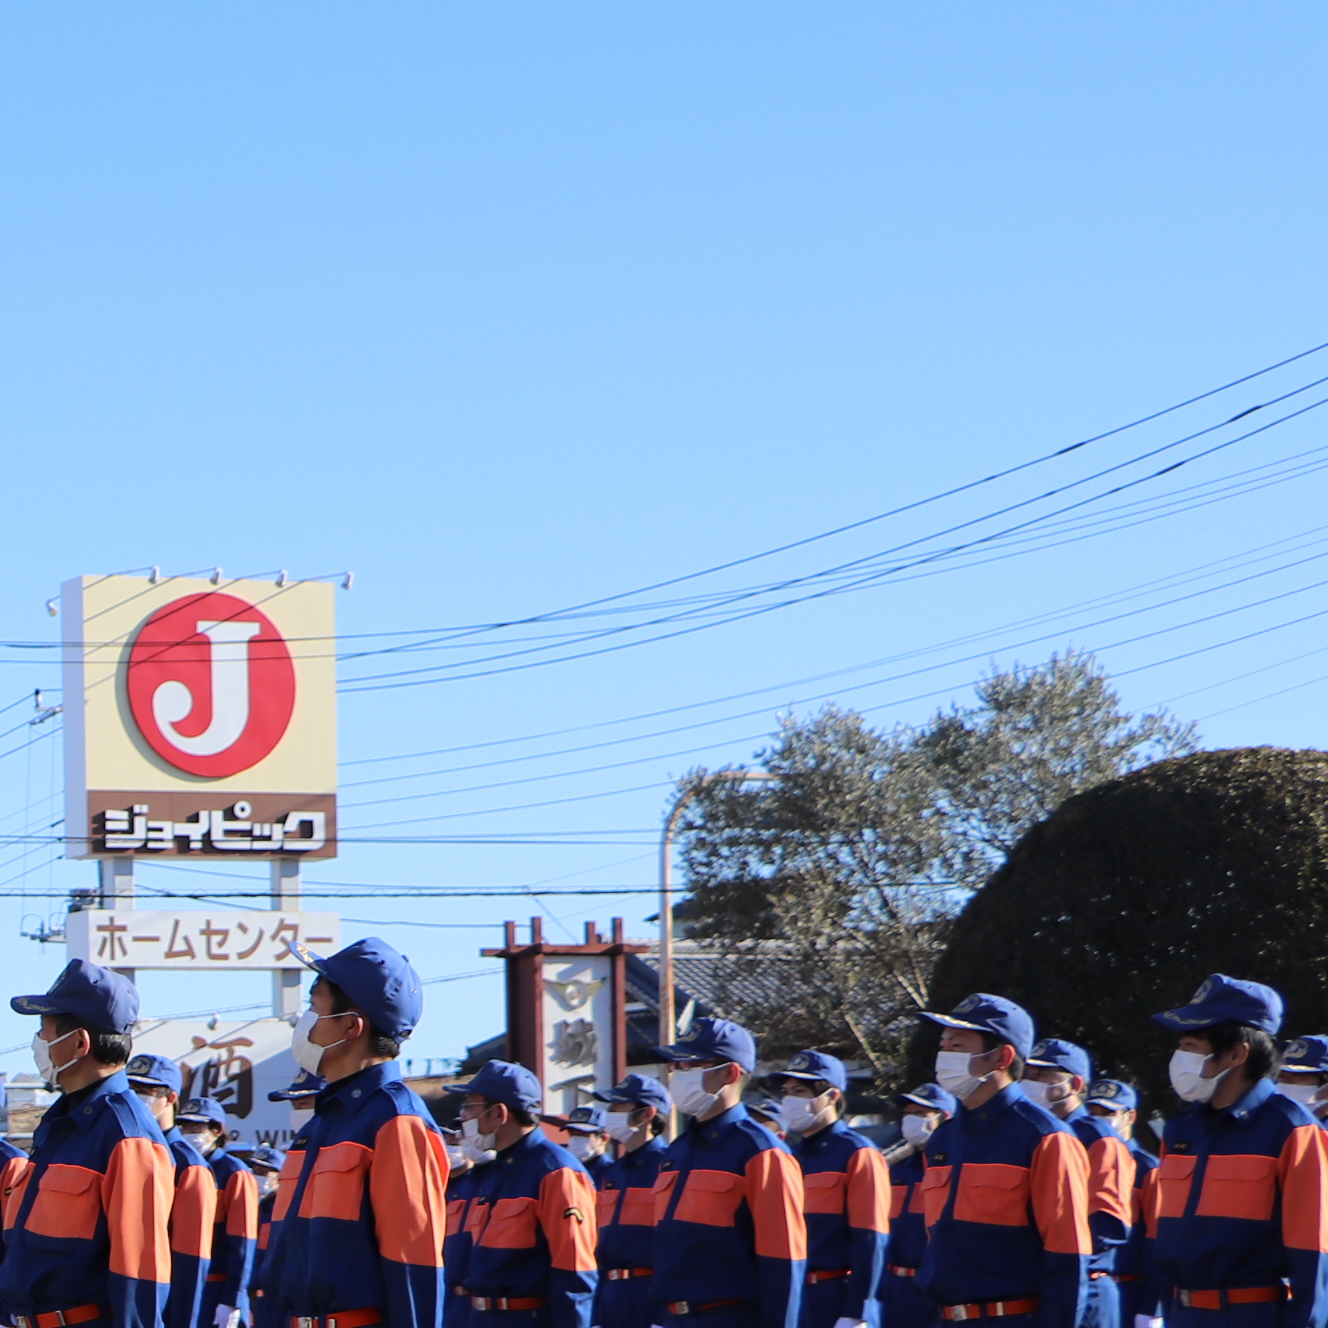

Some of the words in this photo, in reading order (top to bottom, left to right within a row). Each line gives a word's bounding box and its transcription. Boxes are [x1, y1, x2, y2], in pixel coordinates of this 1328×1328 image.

[152, 620, 261, 757] J
[104, 800, 326, 851] ジョイピック
[96, 915, 333, 962] ホームセンター
